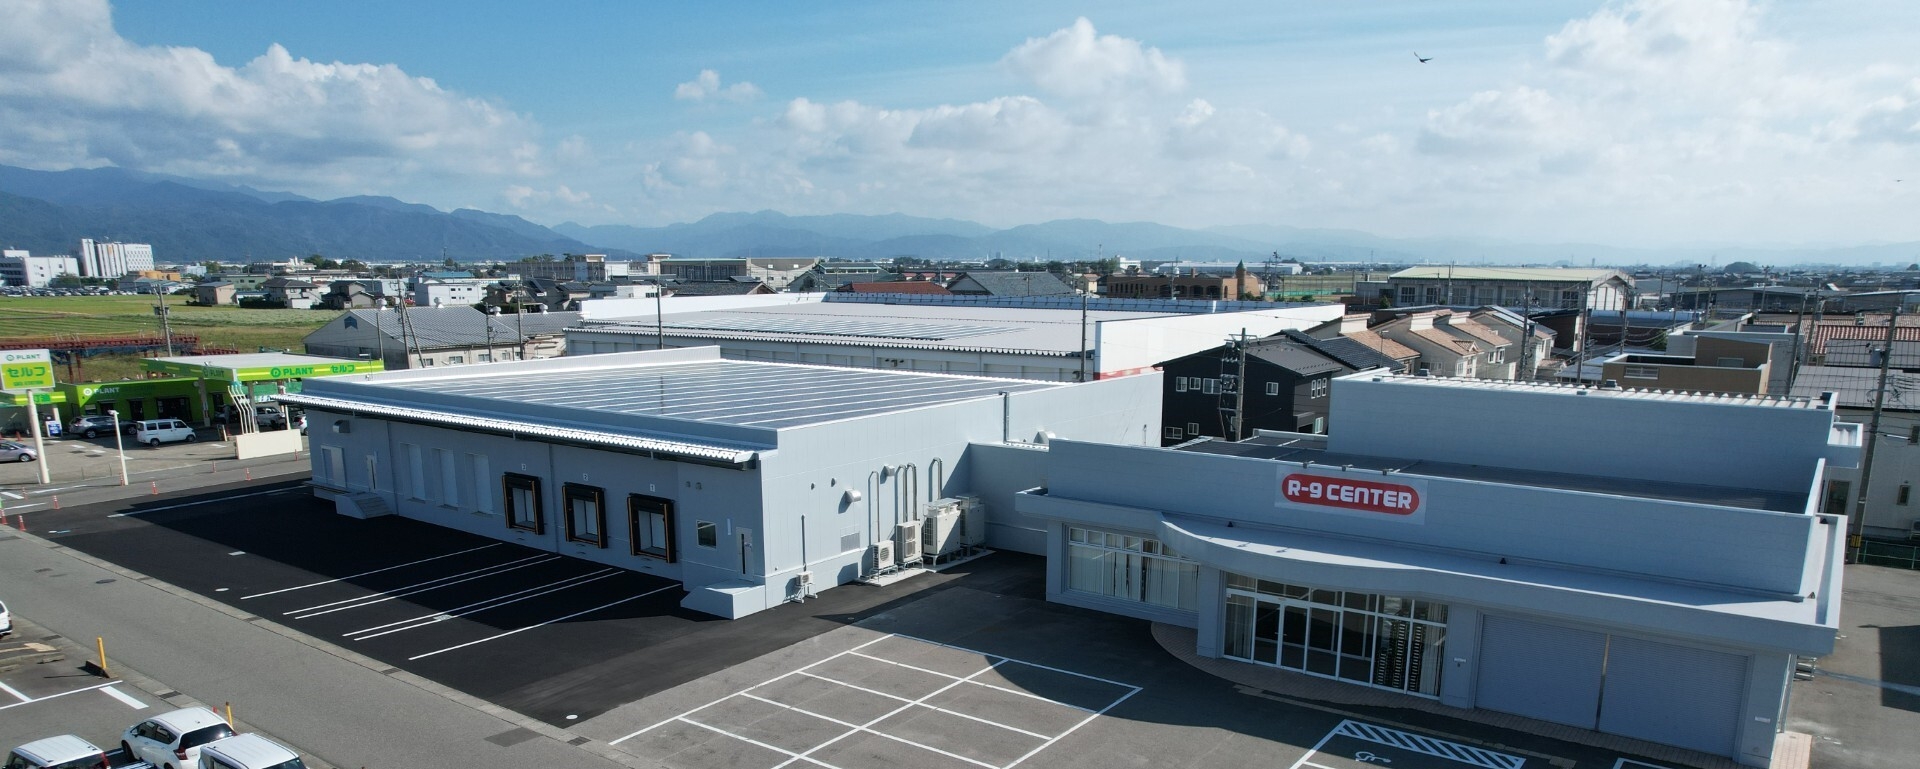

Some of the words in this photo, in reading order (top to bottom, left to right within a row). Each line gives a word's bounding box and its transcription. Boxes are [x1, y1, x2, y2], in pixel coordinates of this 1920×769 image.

[7, 366, 46, 378] セルフ
[283, 366, 314, 376] PLANT
[330, 364, 355, 374] セルフ
[1287, 479, 1323, 499] R-9
[1326, 484, 1412, 510] CENTER
